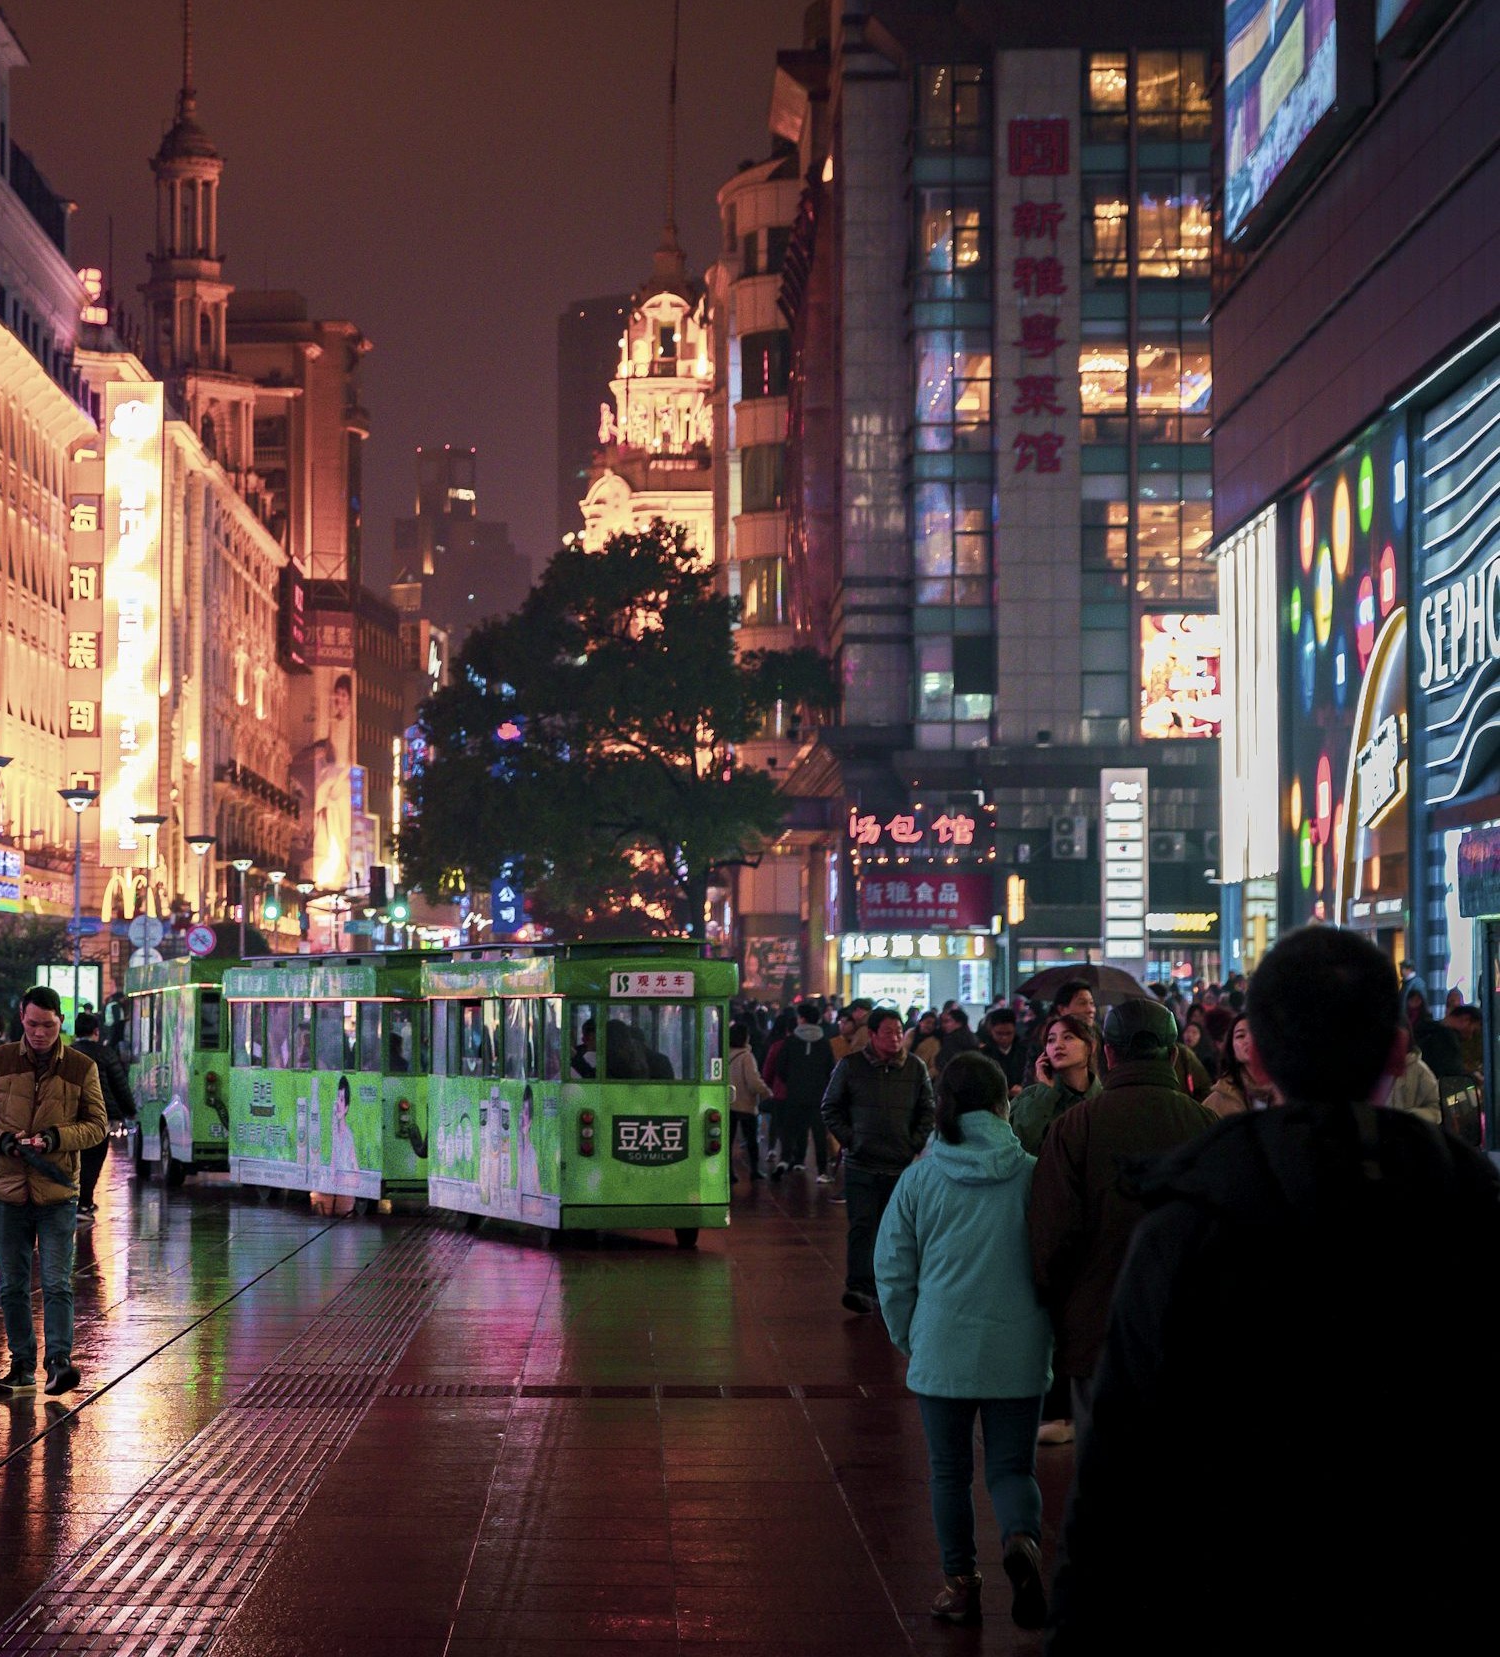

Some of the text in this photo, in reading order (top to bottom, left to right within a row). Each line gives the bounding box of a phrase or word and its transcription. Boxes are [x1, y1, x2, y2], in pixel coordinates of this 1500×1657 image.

[1012, 201, 1066, 473] 新雅粤菜馆
[637, 975, 685, 987] 观光车
[713, 1061, 721, 1077] 8
[618, 1120, 683, 1151] 豆本豆
